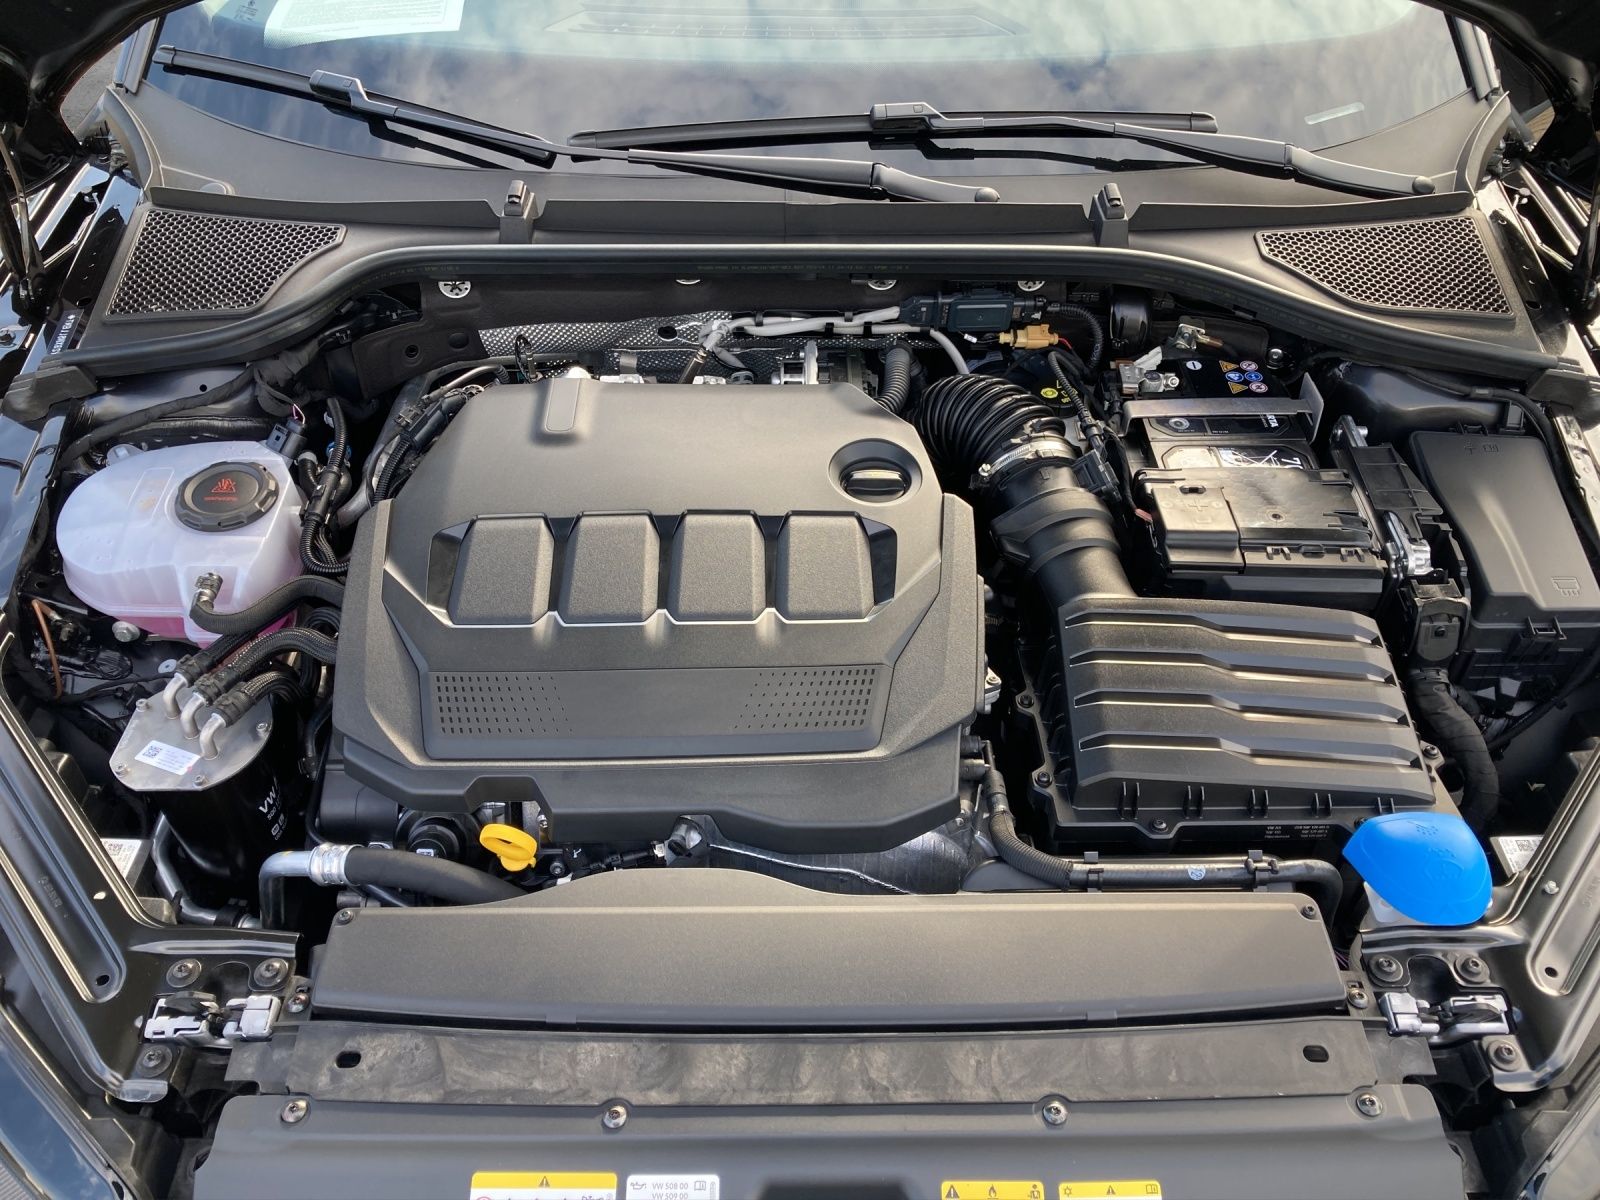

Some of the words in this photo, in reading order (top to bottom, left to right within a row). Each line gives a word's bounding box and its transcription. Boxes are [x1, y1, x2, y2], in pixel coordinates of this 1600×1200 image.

[259, 785, 276, 813] VW
[652, 1182, 663, 1190] VW
[665, 1182, 678, 1190] 508
[679, 1182, 689, 1190] 00
[651, 1192, 663, 1200] VW
[664, 1192, 678, 1200] 509
[679, 1192, 689, 1200] 00
